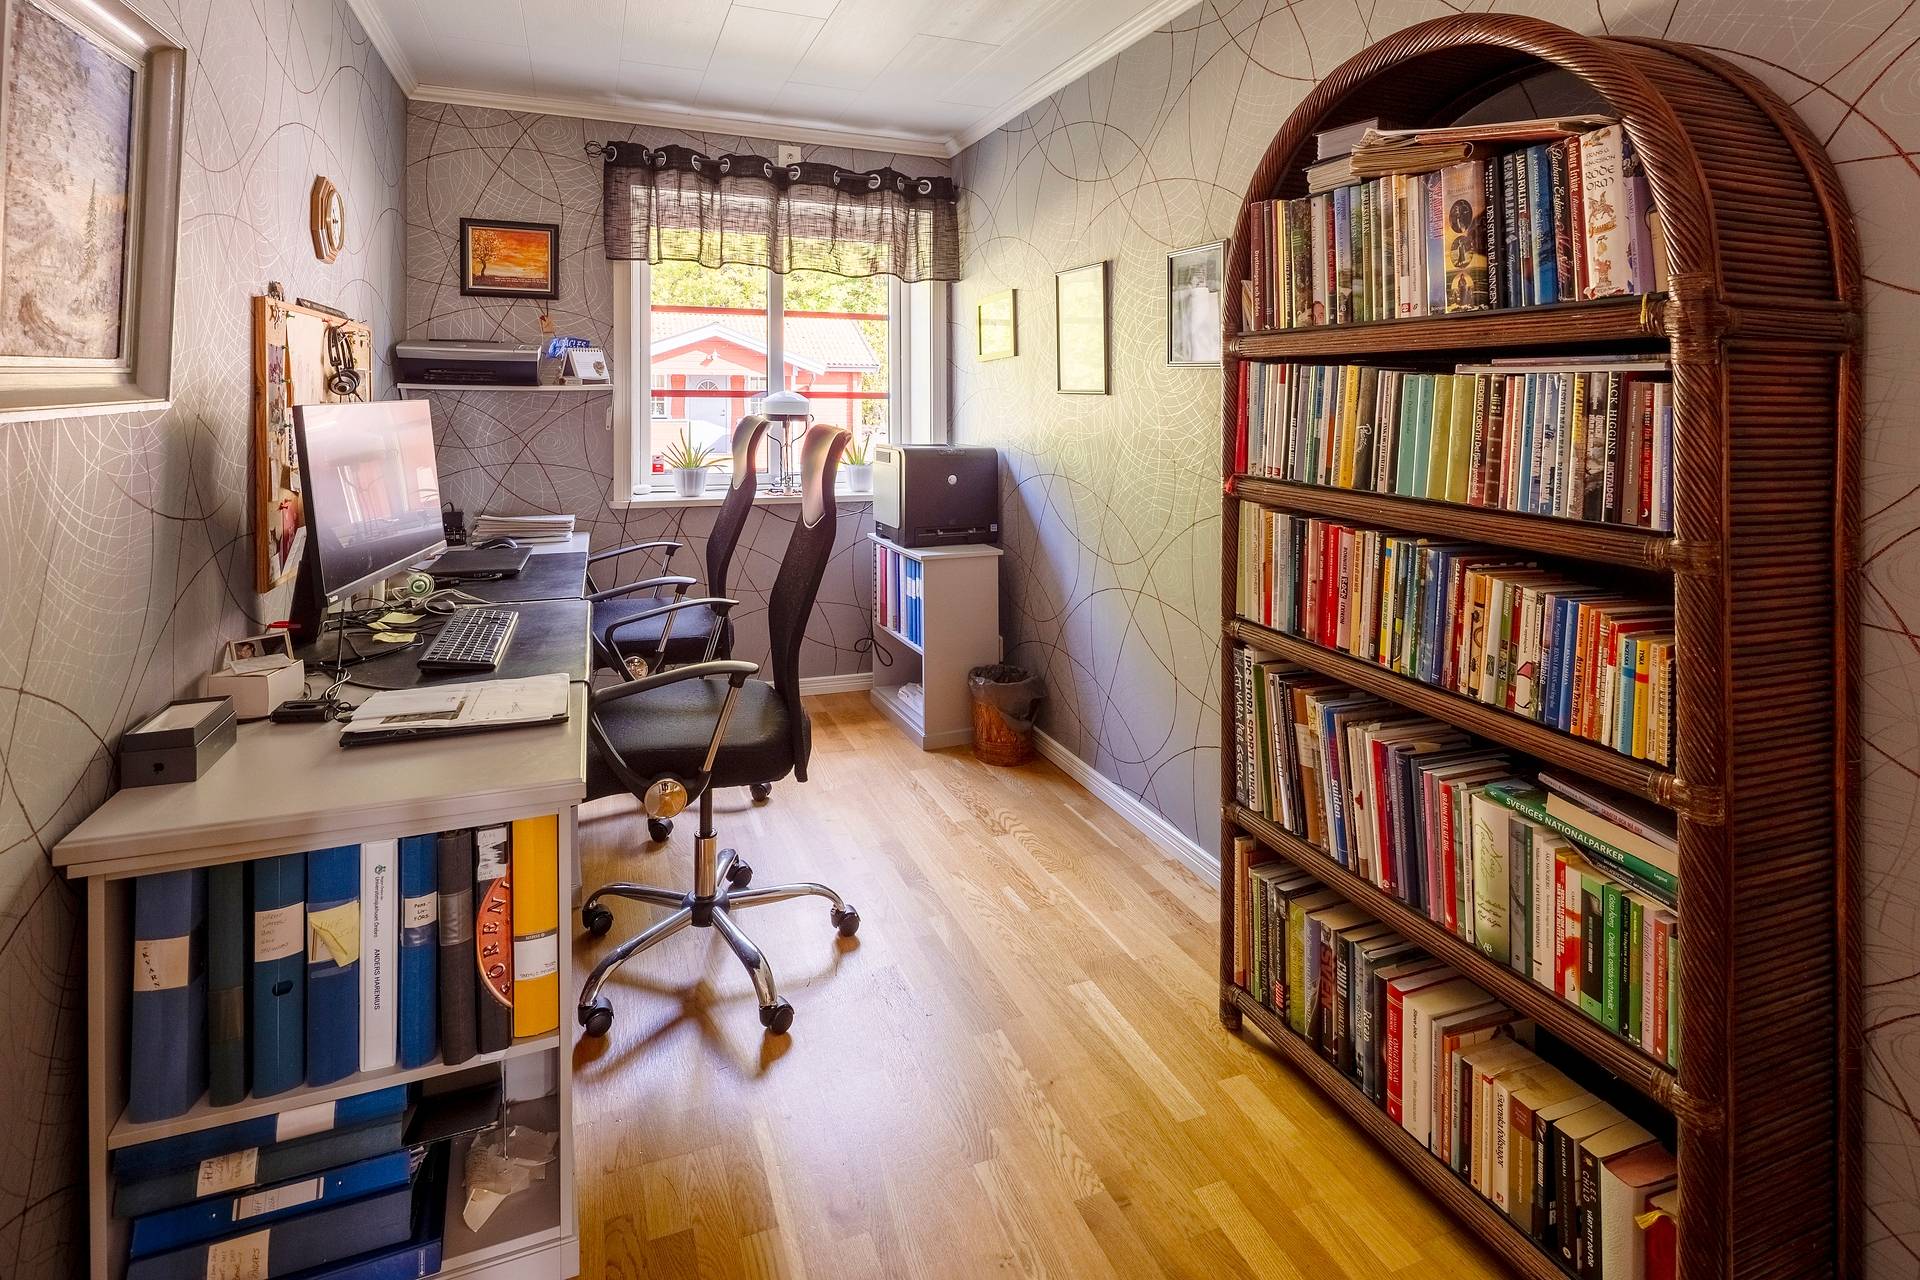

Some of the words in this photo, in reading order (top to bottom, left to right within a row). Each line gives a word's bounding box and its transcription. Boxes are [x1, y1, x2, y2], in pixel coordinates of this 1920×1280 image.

[1503, 155, 1513, 180] KEN
[1516, 154, 1525, 180] JAMES
[1551, 148, 1563, 185] Barbara
[1569, 143, 1578, 168] Barbara
[1570, 169, 1580, 191] Erskine
[1586, 165, 1616, 180] RÖDE
[1586, 178, 1615, 192] ORM
[1505, 181, 1515, 233] FOLLETT
[1518, 180, 1527, 214] FOLLETT
[1553, 186, 1564, 220] Erskine
[1486, 205, 1494, 223] DEN
[1487, 223, 1495, 251] STORA
[1488, 252, 1498, 304] BLÅSNINGEN
[1477, 378, 1485, 411] FREDERICK
[1575, 379, 1584, 401] JACK
[1610, 378, 1618, 404] JACK
[1475, 412, 1484, 441] FORSYTH
[1595, 414, 1605, 438] ÖRNEN
[1608, 410, 1617, 455] HIGGINS
[1472, 468, 1480, 498] protokollet
[1555, 462, 1563, 512] PARTISANER
[1340, 578, 1348, 599] ROCK
[1504, 586, 1512, 616] Blommor
[1234, 666, 1243, 689] ATT
[1576, 656, 1584, 673] ALLA
[1575, 675, 1583, 692] VÅRA
[1235, 691, 1244, 719] VARA
[1235, 722, 1245, 740] PER
[1331, 779, 1342, 818] guiden
[1505, 797, 1544, 822] SVERIGES
[1545, 816, 1625, 863] NATIONALPARKER
[1475, 818, 1494, 882] Roberts
[1490, 844, 1503, 880] Nora
[1606, 910, 1616, 928] Åberg
[1321, 949, 1332, 1009] SVEN
[1337, 960, 1347, 997] CHILD
[1275, 980, 1284, 1008] RUM
[1364, 1009, 1372, 1041] Resan
[1496, 1093, 1506, 1128] Svenska
[1495, 1128, 1506, 1168] folksagor
